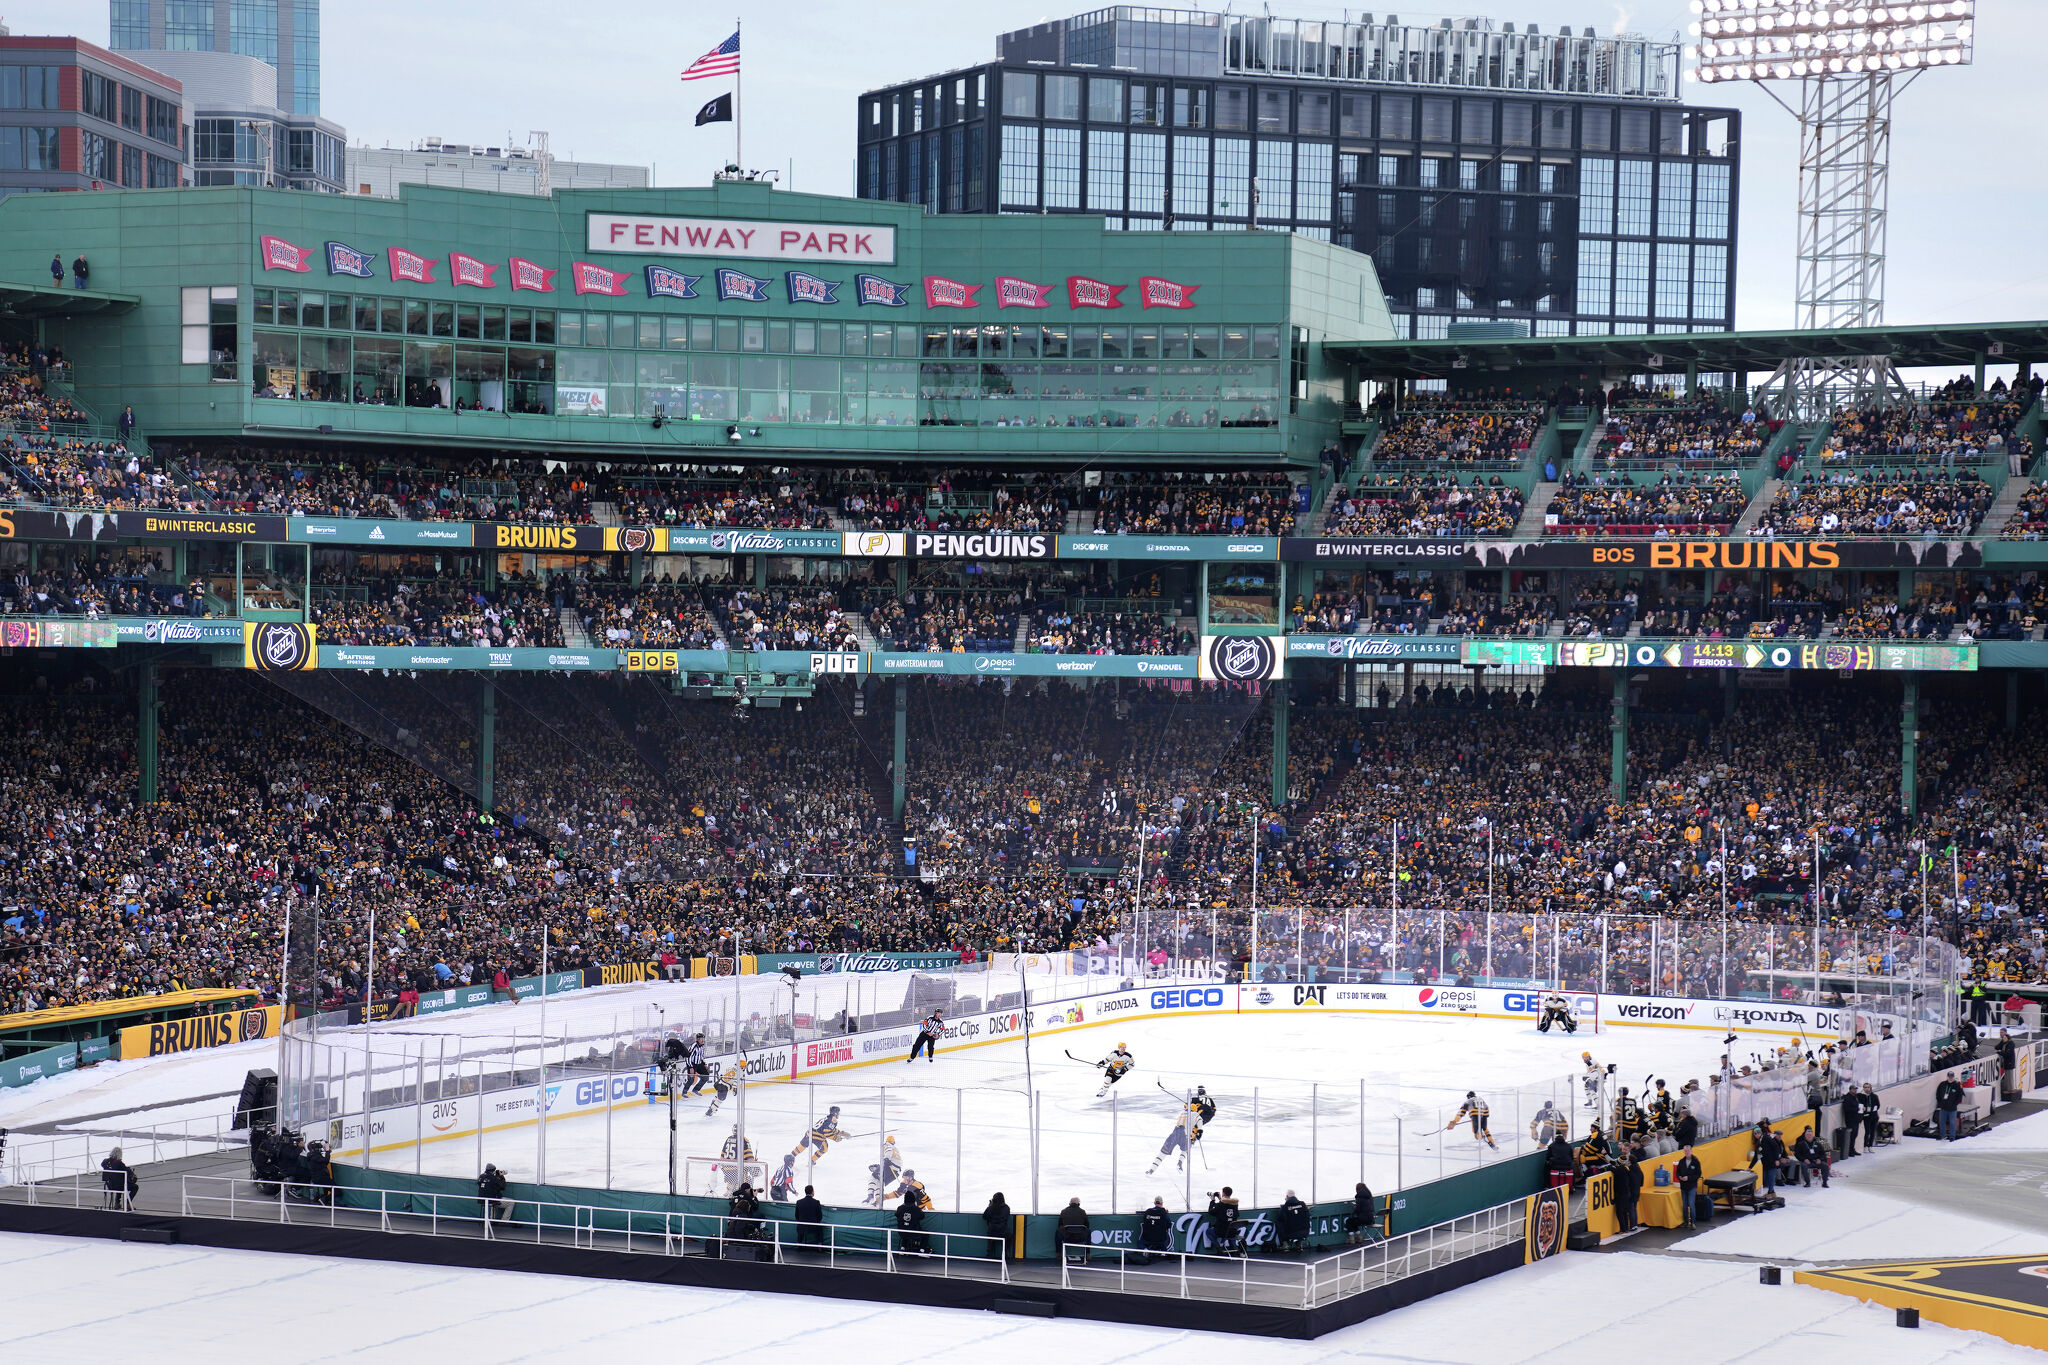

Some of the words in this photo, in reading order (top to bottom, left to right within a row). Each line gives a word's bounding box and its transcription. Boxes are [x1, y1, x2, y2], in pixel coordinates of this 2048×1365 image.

[610, 223, 756, 249] FENWAY
[780, 230, 873, 255] PARK
[269, 245, 299, 264] 1903
[333, 250, 362, 270] 1904
[272, 258, 297, 270] CHAMPIONS
[336, 264, 361, 276] CHAMPIONS
[397, 257, 424, 275] 1912
[458, 262, 484, 280] 1915
[398, 269, 423, 281] CHAMPIONS
[460, 274, 484, 286] CHAMPIONS
[518, 267, 543, 285] 1916
[583, 271, 613, 288] 1918
[653, 273, 686, 292] 1946
[519, 279, 543, 291] CHAMPIONS
[584, 283, 613, 294] CHAMPIONS
[655, 286, 684, 298] CHAMPIONS
[724, 276, 757, 294] 1967
[794, 279, 827, 297] 1975
[863, 281, 896, 300] 1986
[931, 284, 966, 301] 2004
[1002, 284, 1039, 301] 2007
[1075, 284, 1111, 301] 2013
[1147, 284, 1183, 302] 2018
[726, 289, 755, 300] CHAMPIONS
[797, 292, 824, 302] CHAMPIONS
[866, 294, 893, 305] CHAMPIONS
[935, 296, 963, 306] CHAMPIONS
[1005, 297, 1036, 306] CHAMPIONS
[1078, 297, 1108, 307] CHAMPIONS
[1150, 297, 1180, 307] CHAMPIONS
[146, 517, 256, 534] #WINTERCLASSIC
[423, 530, 458, 539] MassMutual
[496, 525, 578, 550] BRUINS
[673, 536, 708, 545] DISCOVER
[726, 530, 784, 553] Winter
[786, 538, 837, 548] CLASSIC
[915, 534, 1046, 558] PENGUINS
[1072, 542, 1109, 551] DISCOVER
[1227, 544, 1264, 552] GEICO
[1316, 542, 1462, 558] #WINTERCLASSIC
[1592, 547, 1636, 563] BOS
[1650, 540, 1841, 569] BRUINS
[53, 633, 63, 645] 2
[157, 619, 202, 644] Winter
[203, 627, 241, 637] CLASSIC
[273, 637, 292, 657] NHL
[1290, 642, 1326, 651] DISCOVER
[1343, 637, 1402, 659] Winter
[1404, 644, 1457, 653] CLASSIC
[1527, 644, 1546, 652] SOG
[1693, 645, 1734, 657] 14:13
[411, 655, 451, 664] ticketmaster
[489, 653, 512, 661] TRULY
[629, 654, 676, 667] BOS
[812, 656, 857, 670] PIT
[884, 659, 895, 668] NEW
[895, 659, 928, 668] AMSTERDAM
[989, 658, 1016, 667] pepsi
[1232, 651, 1252, 670] NHL
[1693, 658, 1726, 667] PERIOD
[1727, 658, 1734, 667] 1
[1891, 656, 1903, 668] 2
[1056, 661, 1092, 671] verizon
[1149, 663, 1183, 671] FANDUEL
[777, 960, 815, 970] DISCOVER
[835, 953, 900, 972] Winter
[601, 960, 660, 984] BRUINS
[468, 991, 487, 1002] GEICO
[514, 984, 534, 994] HONDA
[1293, 985, 1327, 1006] CAT
[1336, 991, 1351, 1000] LET'S
[1351, 992, 1359, 1000] DO
[1359, 992, 1370, 1000] THE
[1370, 992, 1388, 1000] WORK.
[1440, 990, 1476, 1004] pepsi
[422, 998, 444, 1009] DISCOVER
[1103, 998, 1138, 1012] HONDA
[1151, 988, 1223, 1010] GEICO
[1617, 1001, 1686, 1019] verizon
[1732, 1009, 1807, 1024] HONDA
[149, 1013, 233, 1057] BRUINS
[940, 1025, 958, 1040] reat
[959, 1020, 980, 1038] Clips
[863, 1041, 872, 1053] NEW
[872, 1036, 900, 1051] AMSTERDAM
[900, 1033, 913, 1047] VODKA
[746, 1050, 785, 1076] adiclub
[818, 1048, 854, 1066] HYDRATION.
[576, 1076, 639, 1106] GEICO
[432, 1102, 457, 1120] aws
[495, 1103, 507, 1113] THE
[507, 1100, 523, 1111] BEST
[524, 1098, 535, 1109] RUN
[724, 1143, 737, 1160] 35
[1592, 1176, 1616, 1211] BRU
[1393, 1199, 1407, 1211] 2023
